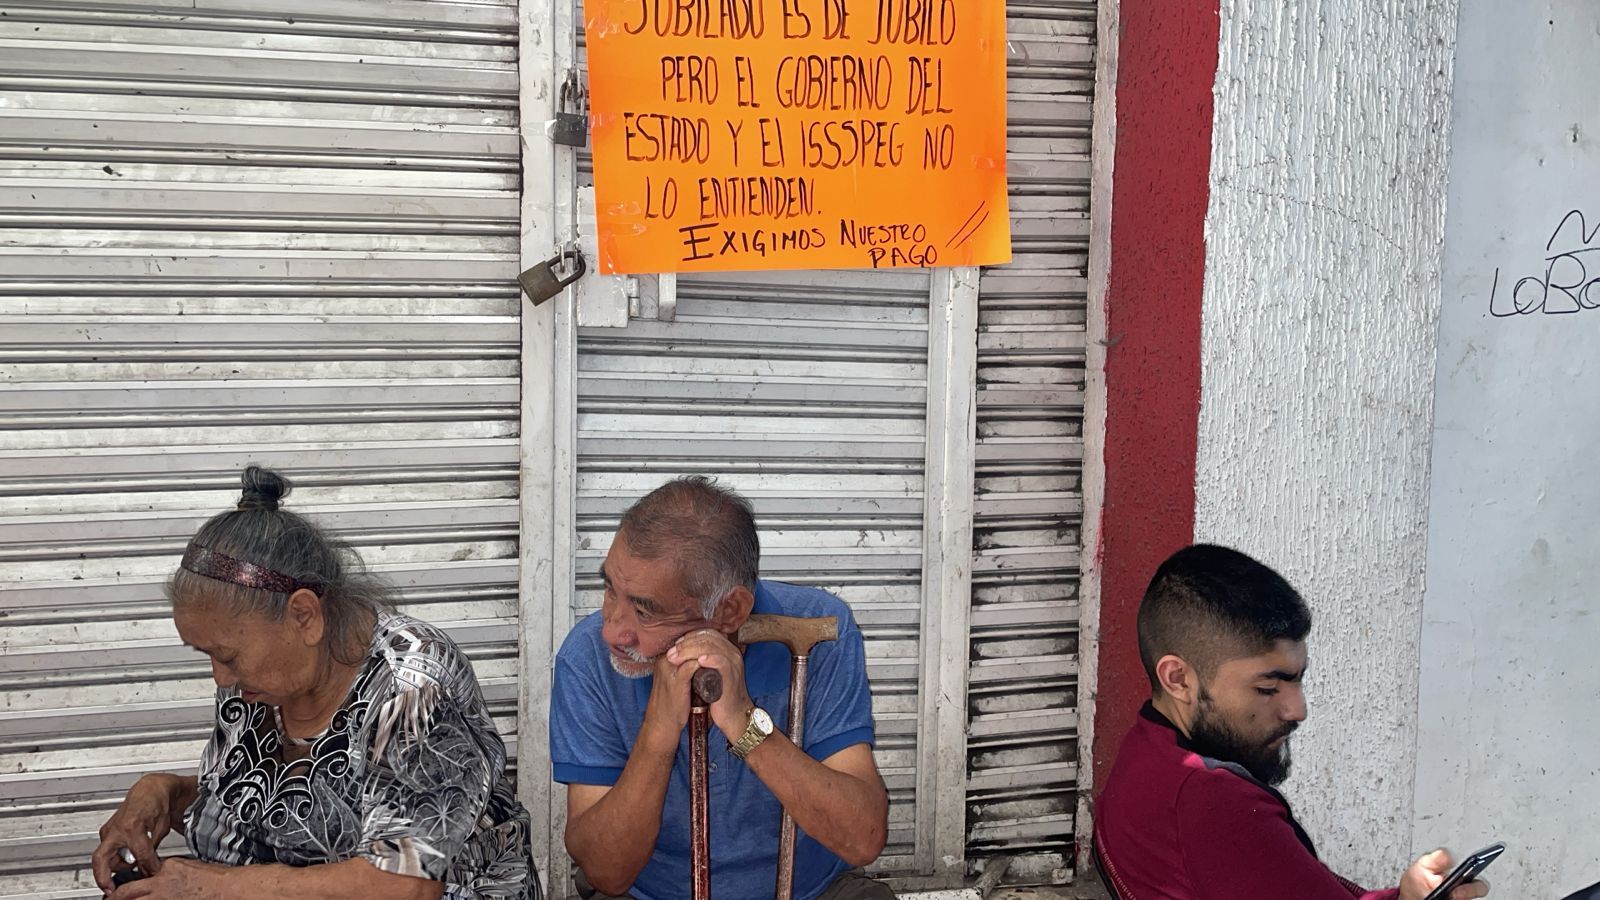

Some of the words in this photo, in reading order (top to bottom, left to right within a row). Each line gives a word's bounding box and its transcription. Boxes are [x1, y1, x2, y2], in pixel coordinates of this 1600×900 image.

[623, 0, 764, 39] JUBILADO
[782, 0, 812, 39] ES
[822, 0, 851, 40] DE
[867, 0, 956, 46] JUBILO
[661, 55, 719, 105] PERO
[735, 56, 760, 108] EL
[776, 54, 892, 111] GOBIERNO
[905, 57, 953, 116] DEL
[623, 112, 710, 163] ESTADO
[726, 119, 743, 167] Y
[800, 120, 904, 170] ISSSPEG
[923, 123, 955, 170] NO
[645, 176, 678, 220] LO
[698, 176, 822, 221] ENTIENDEN.
[869, 244, 938, 269] PAGO
